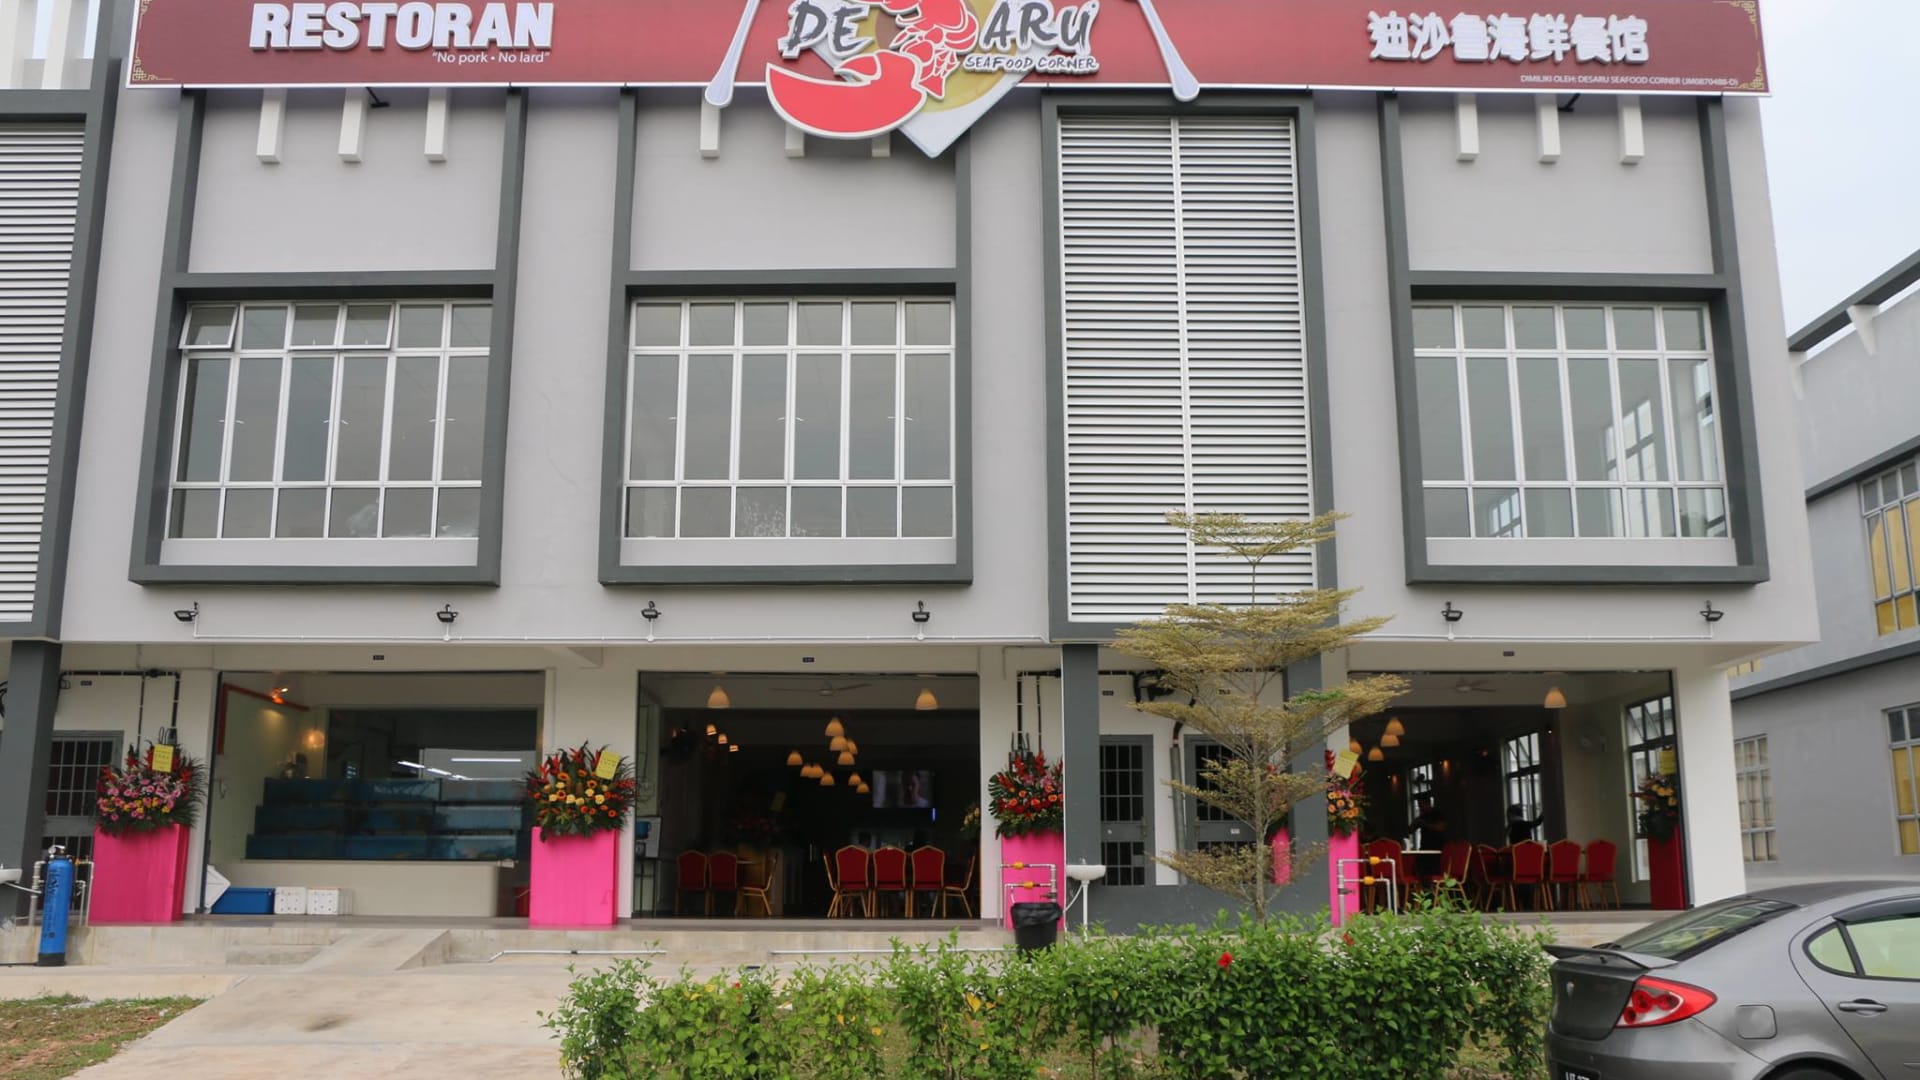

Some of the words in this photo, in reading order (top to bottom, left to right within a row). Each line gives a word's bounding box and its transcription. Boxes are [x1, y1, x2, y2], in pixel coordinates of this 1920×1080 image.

[249, 2, 555, 50] RESTORAN
[1368, 10, 1649, 63] 迪沙鲁海鲜餐馆
[458, 52, 488, 65] pork
[498, 52, 518, 63] No
[965, 56, 1033, 69] SEAFOOD
[1037, 56, 1097, 70] CORNER
[1578, 75, 1609, 84] DESARU
[1610, 76, 1648, 84] SEAFOOD
[1649, 76, 1681, 85] CORNER
